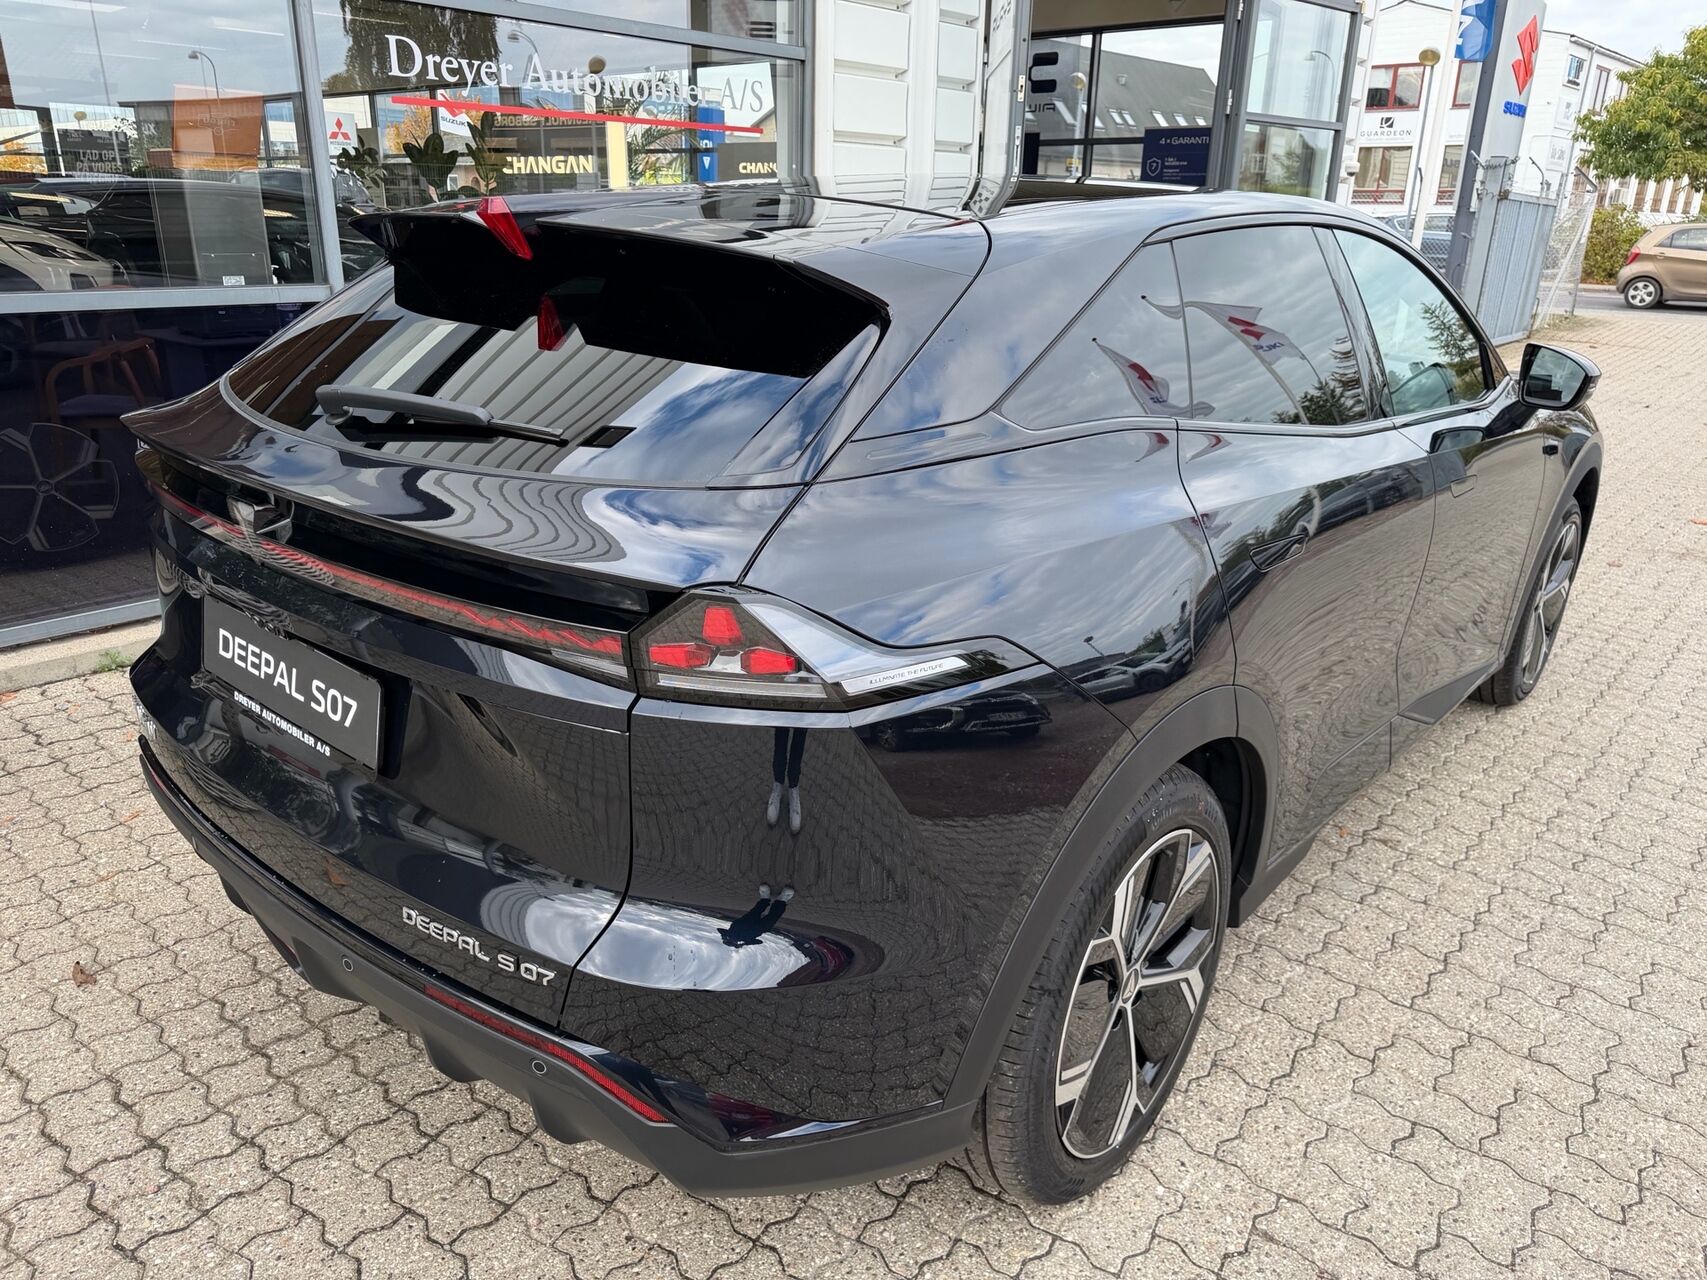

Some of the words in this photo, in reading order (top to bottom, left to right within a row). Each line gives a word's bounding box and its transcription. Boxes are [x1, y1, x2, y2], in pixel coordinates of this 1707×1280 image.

[385, 34, 514, 96] Dreyer
[522, 53, 711, 107] Automobiler
[720, 76, 763, 112] A/S
[440, 116, 467, 127] SUZUK
[79, 149, 99, 161] LAD
[1171, 136, 1210, 145] GARANTI
[92, 161, 123, 173] VORES
[219, 628, 304, 703] DEEPAL
[310, 679, 358, 728] S07
[233, 690, 261, 715] DREYER
[261, 708, 315, 748] AUTOMOBILER
[316, 741, 331, 757] A/S
[402, 906, 492, 962] DEEPAL
